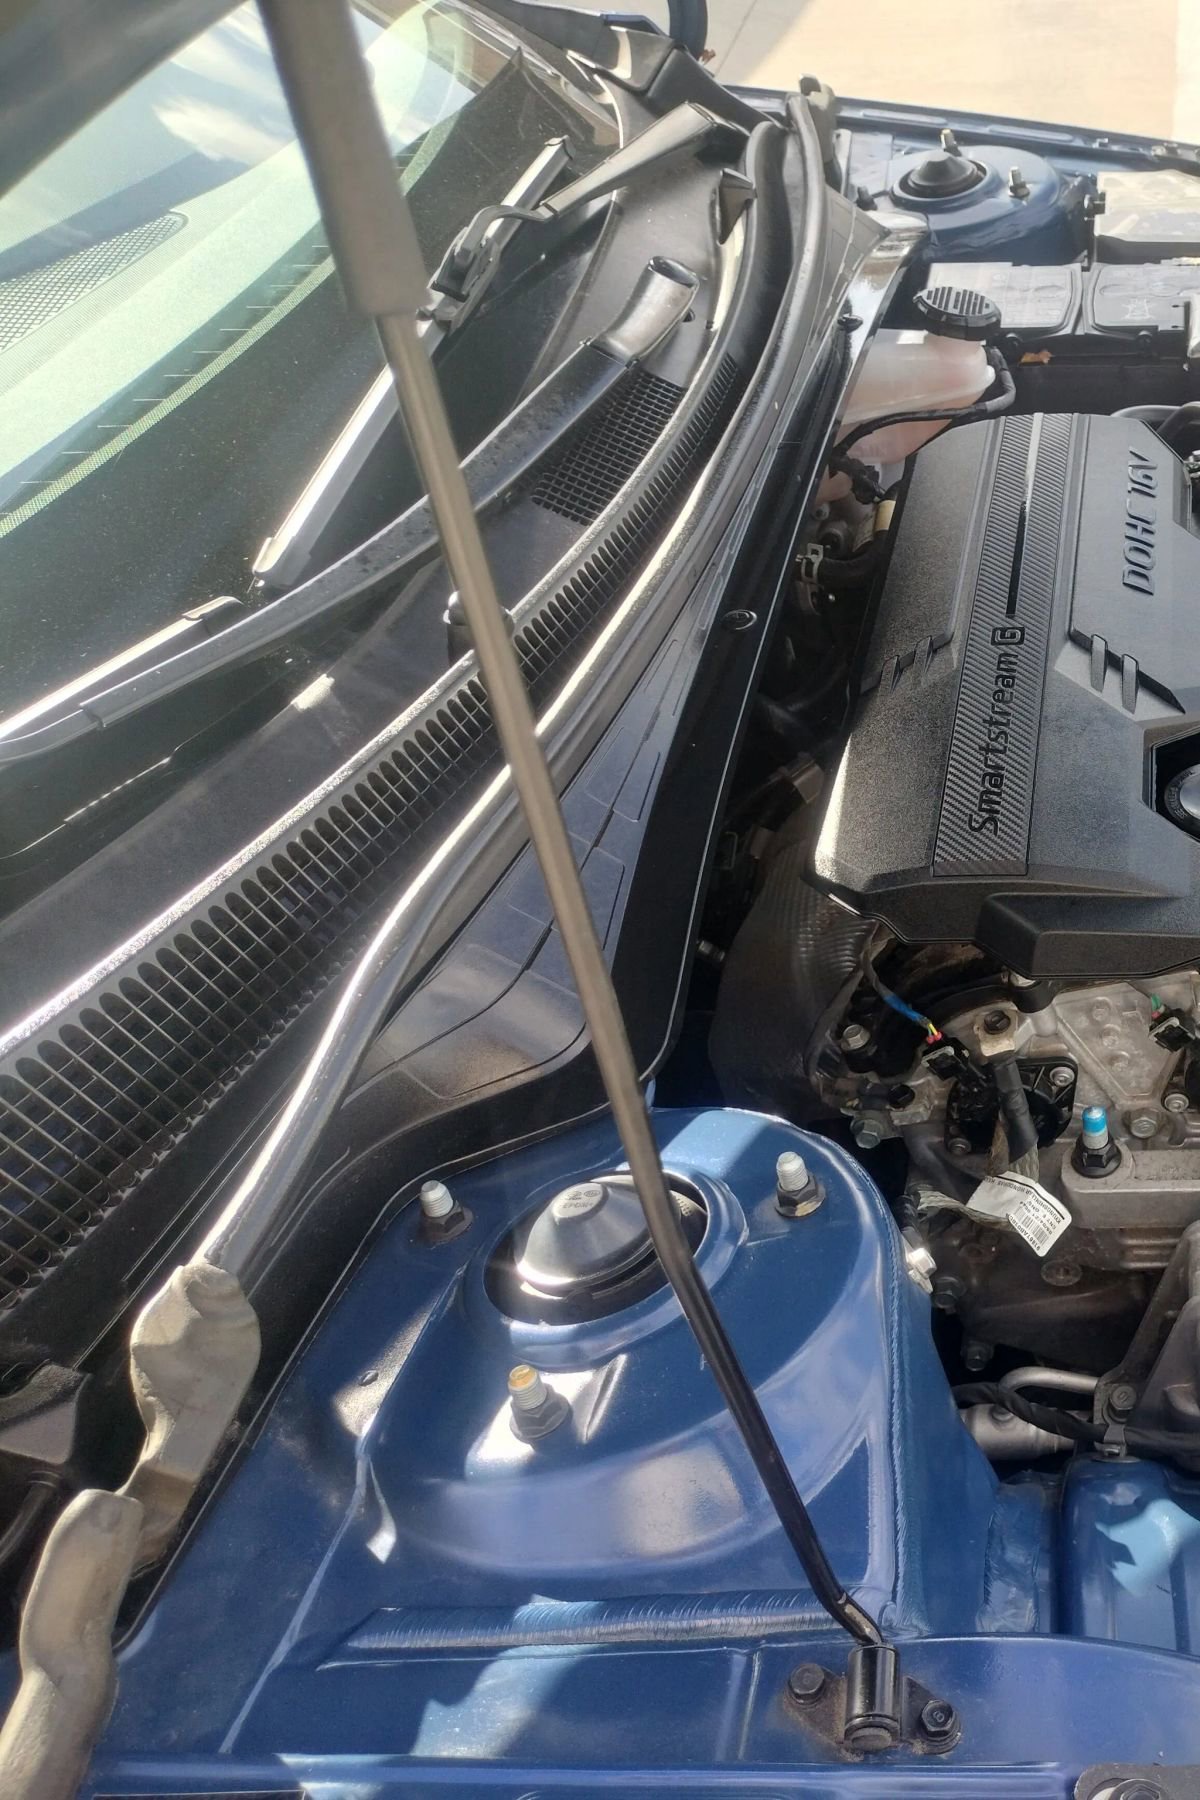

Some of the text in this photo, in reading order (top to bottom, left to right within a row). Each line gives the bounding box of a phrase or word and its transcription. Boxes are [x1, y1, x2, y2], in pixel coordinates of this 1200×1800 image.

[1122, 446, 1158, 596] DOHC 16V
[967, 652, 1019, 837] Smartstream
